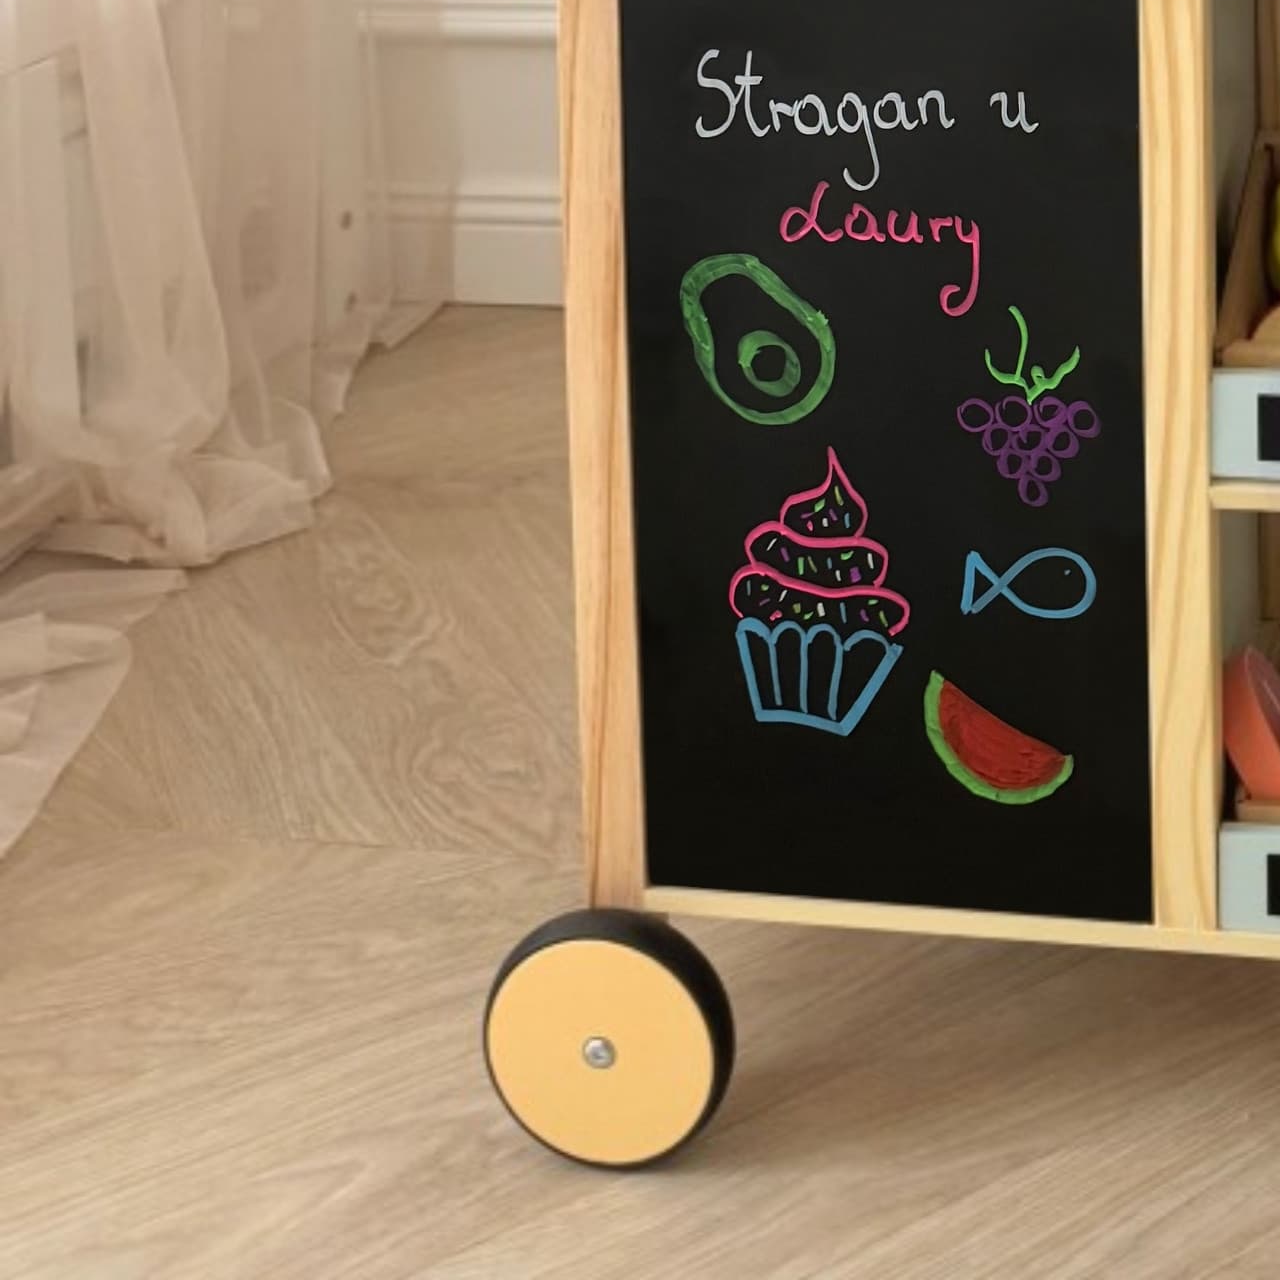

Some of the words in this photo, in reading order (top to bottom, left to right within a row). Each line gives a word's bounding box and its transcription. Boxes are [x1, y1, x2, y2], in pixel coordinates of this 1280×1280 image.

[695, 49, 955, 192] Stragan
[988, 91, 1040, 134] u
[777, 180, 981, 318] Laury
